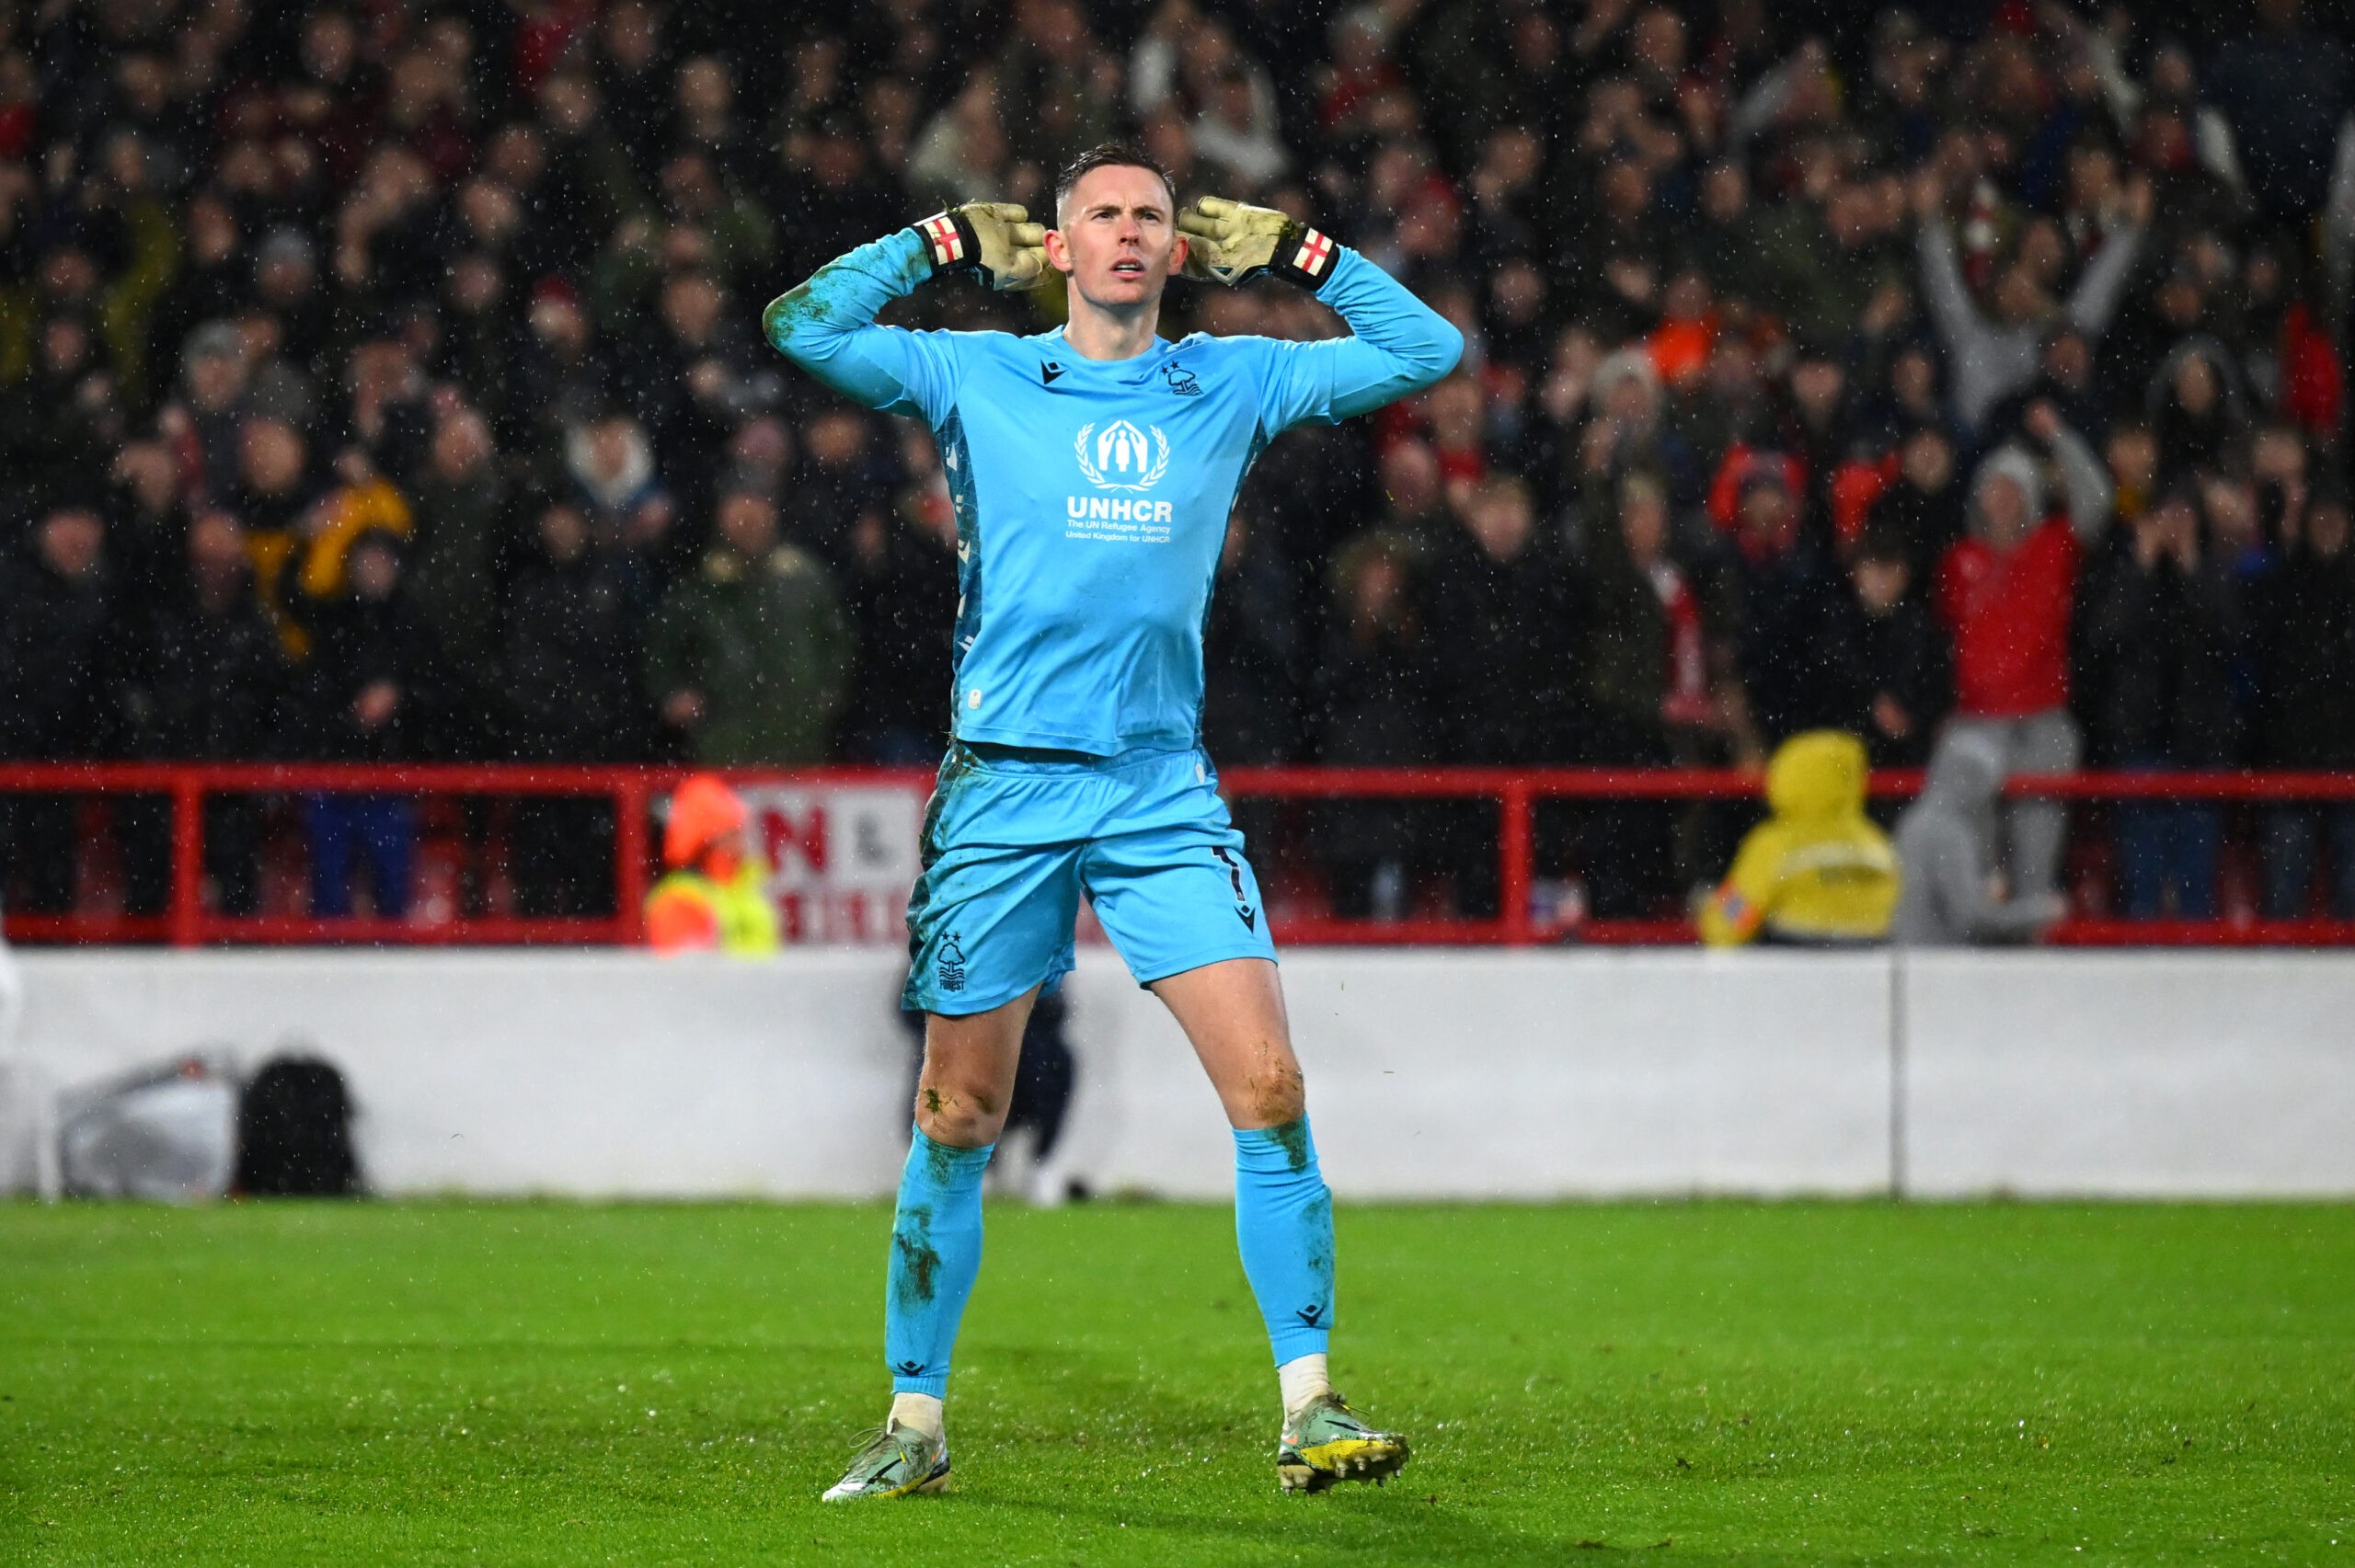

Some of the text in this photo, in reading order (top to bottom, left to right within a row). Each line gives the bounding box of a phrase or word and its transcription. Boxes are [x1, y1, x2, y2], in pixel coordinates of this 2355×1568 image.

[1067, 496, 1172, 522] UNHCR
[1067, 520, 1171, 534] The UN Refugee Agency
[1065, 531, 1091, 539] United
[1093, 532, 1128, 542] Kingdom
[1142, 535, 1170, 544] UNHCR
[939, 979, 965, 992] FOREST
